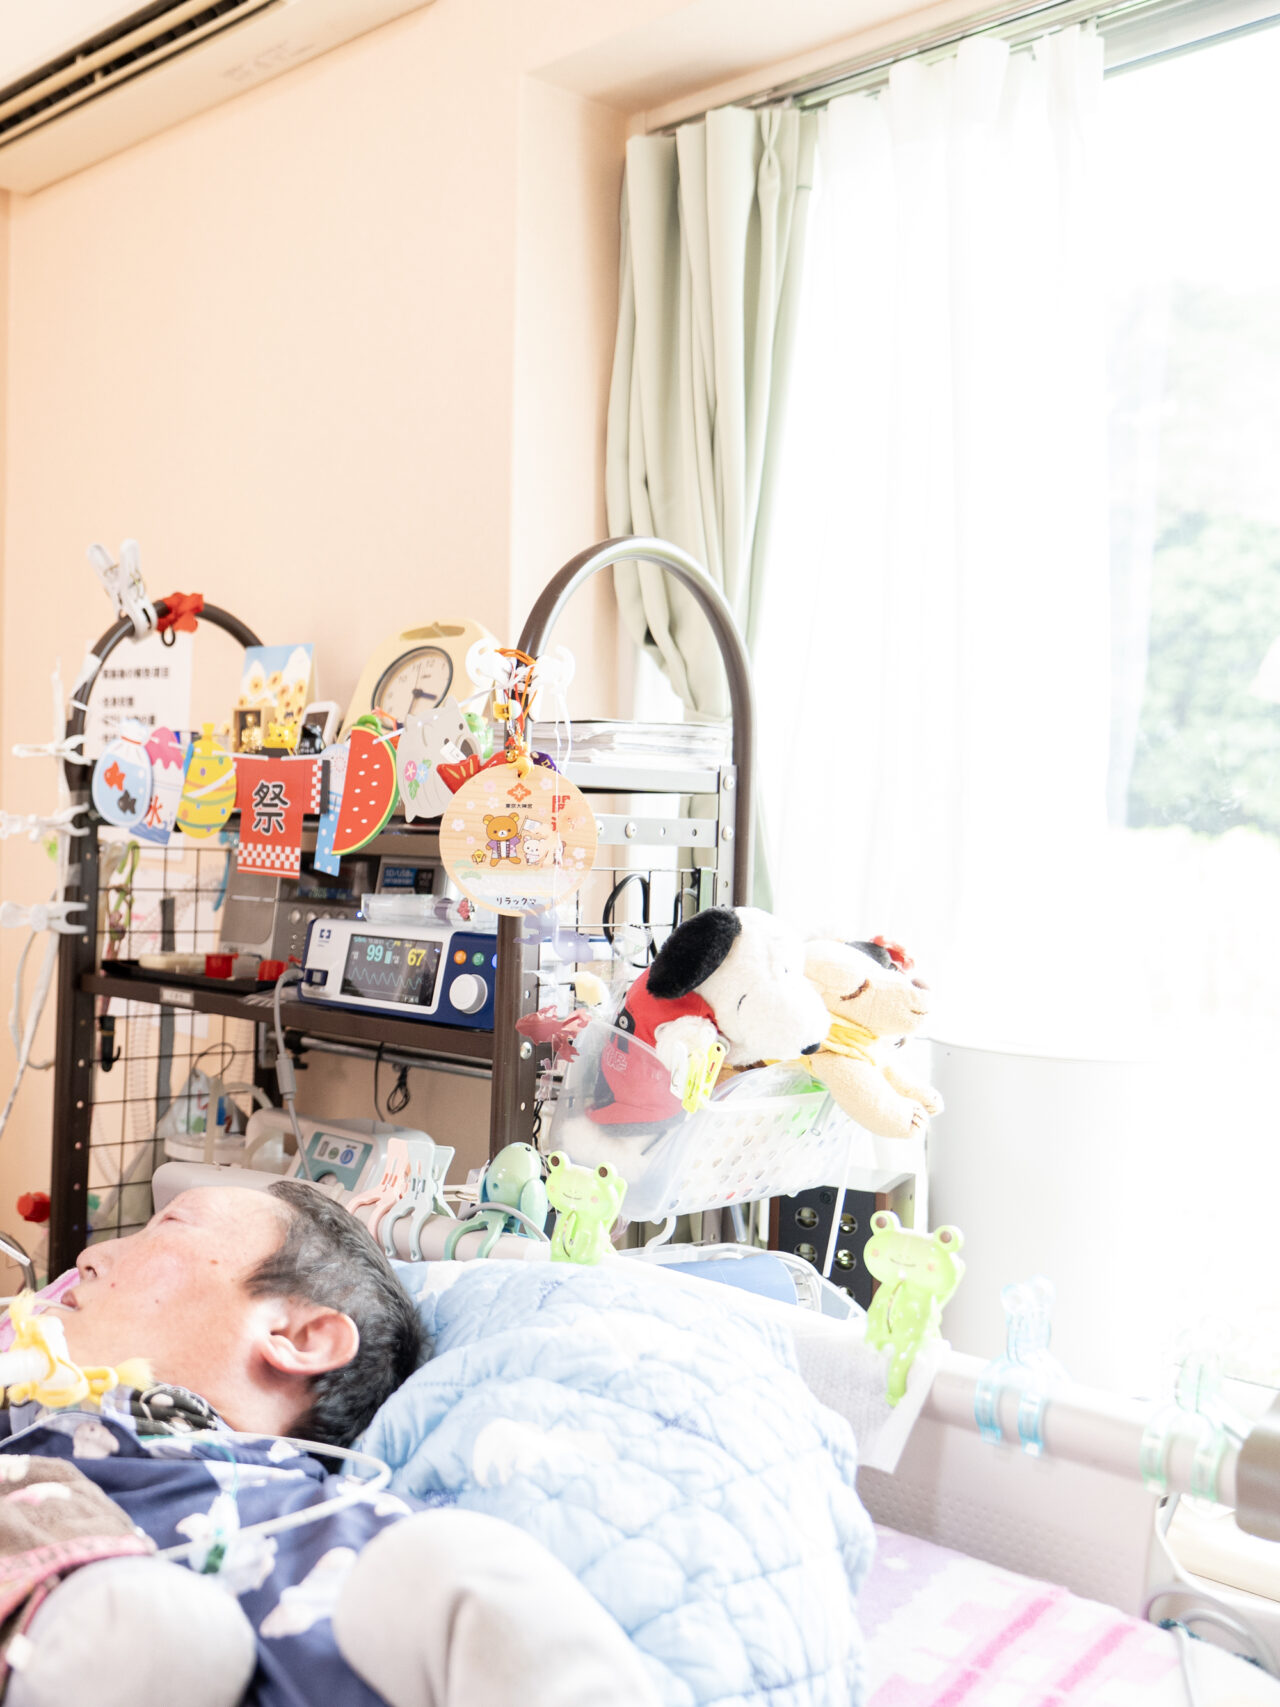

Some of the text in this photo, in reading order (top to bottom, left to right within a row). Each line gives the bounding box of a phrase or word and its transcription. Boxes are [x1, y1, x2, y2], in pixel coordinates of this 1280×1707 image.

[252, 780, 290, 835] 祭
[366, 944, 384, 962] 99
[407, 949, 426, 966] 67
